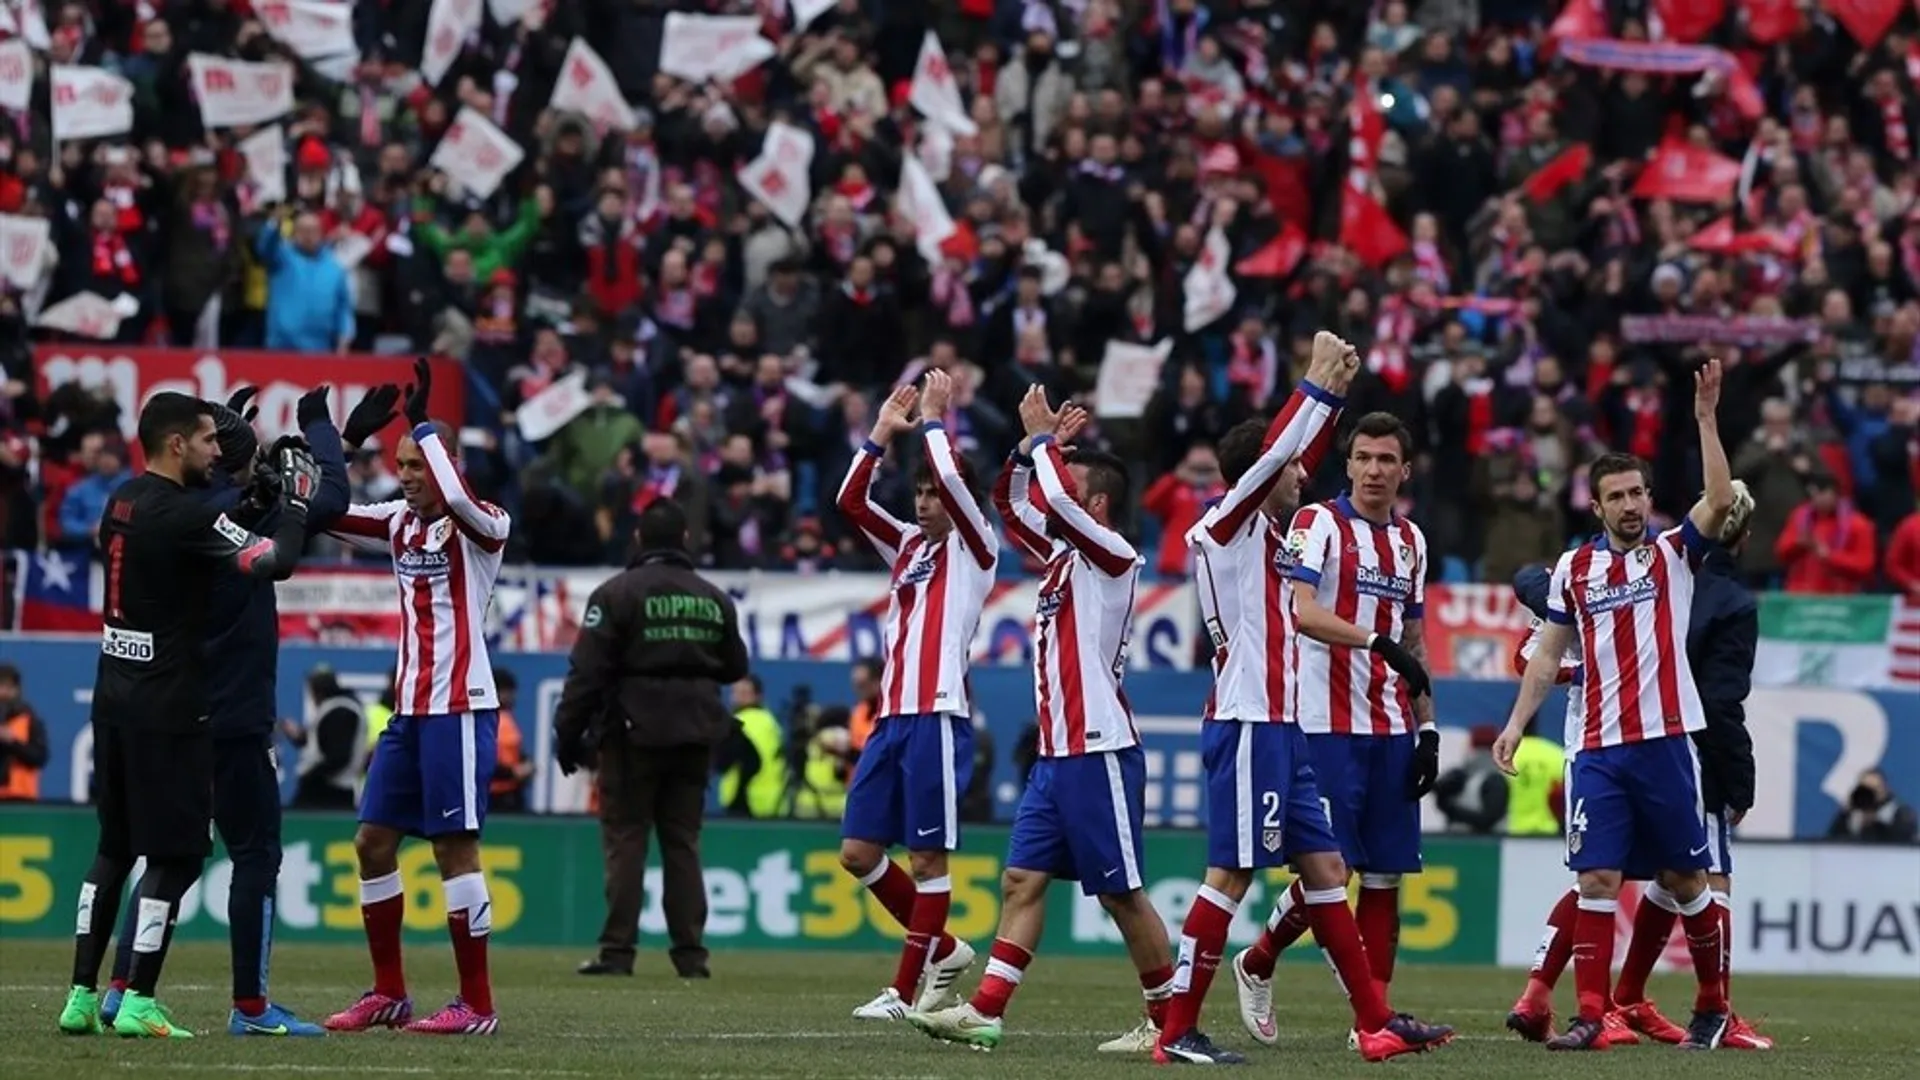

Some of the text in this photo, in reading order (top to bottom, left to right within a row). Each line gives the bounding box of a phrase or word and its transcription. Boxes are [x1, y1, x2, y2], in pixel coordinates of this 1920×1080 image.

[1357, 566, 1389, 587] Baku
[1585, 583, 1620, 604] Baku
[1622, 577, 1655, 597] 2015
[1262, 791, 1280, 828] 2
[1752, 899, 1920, 954] HUA
